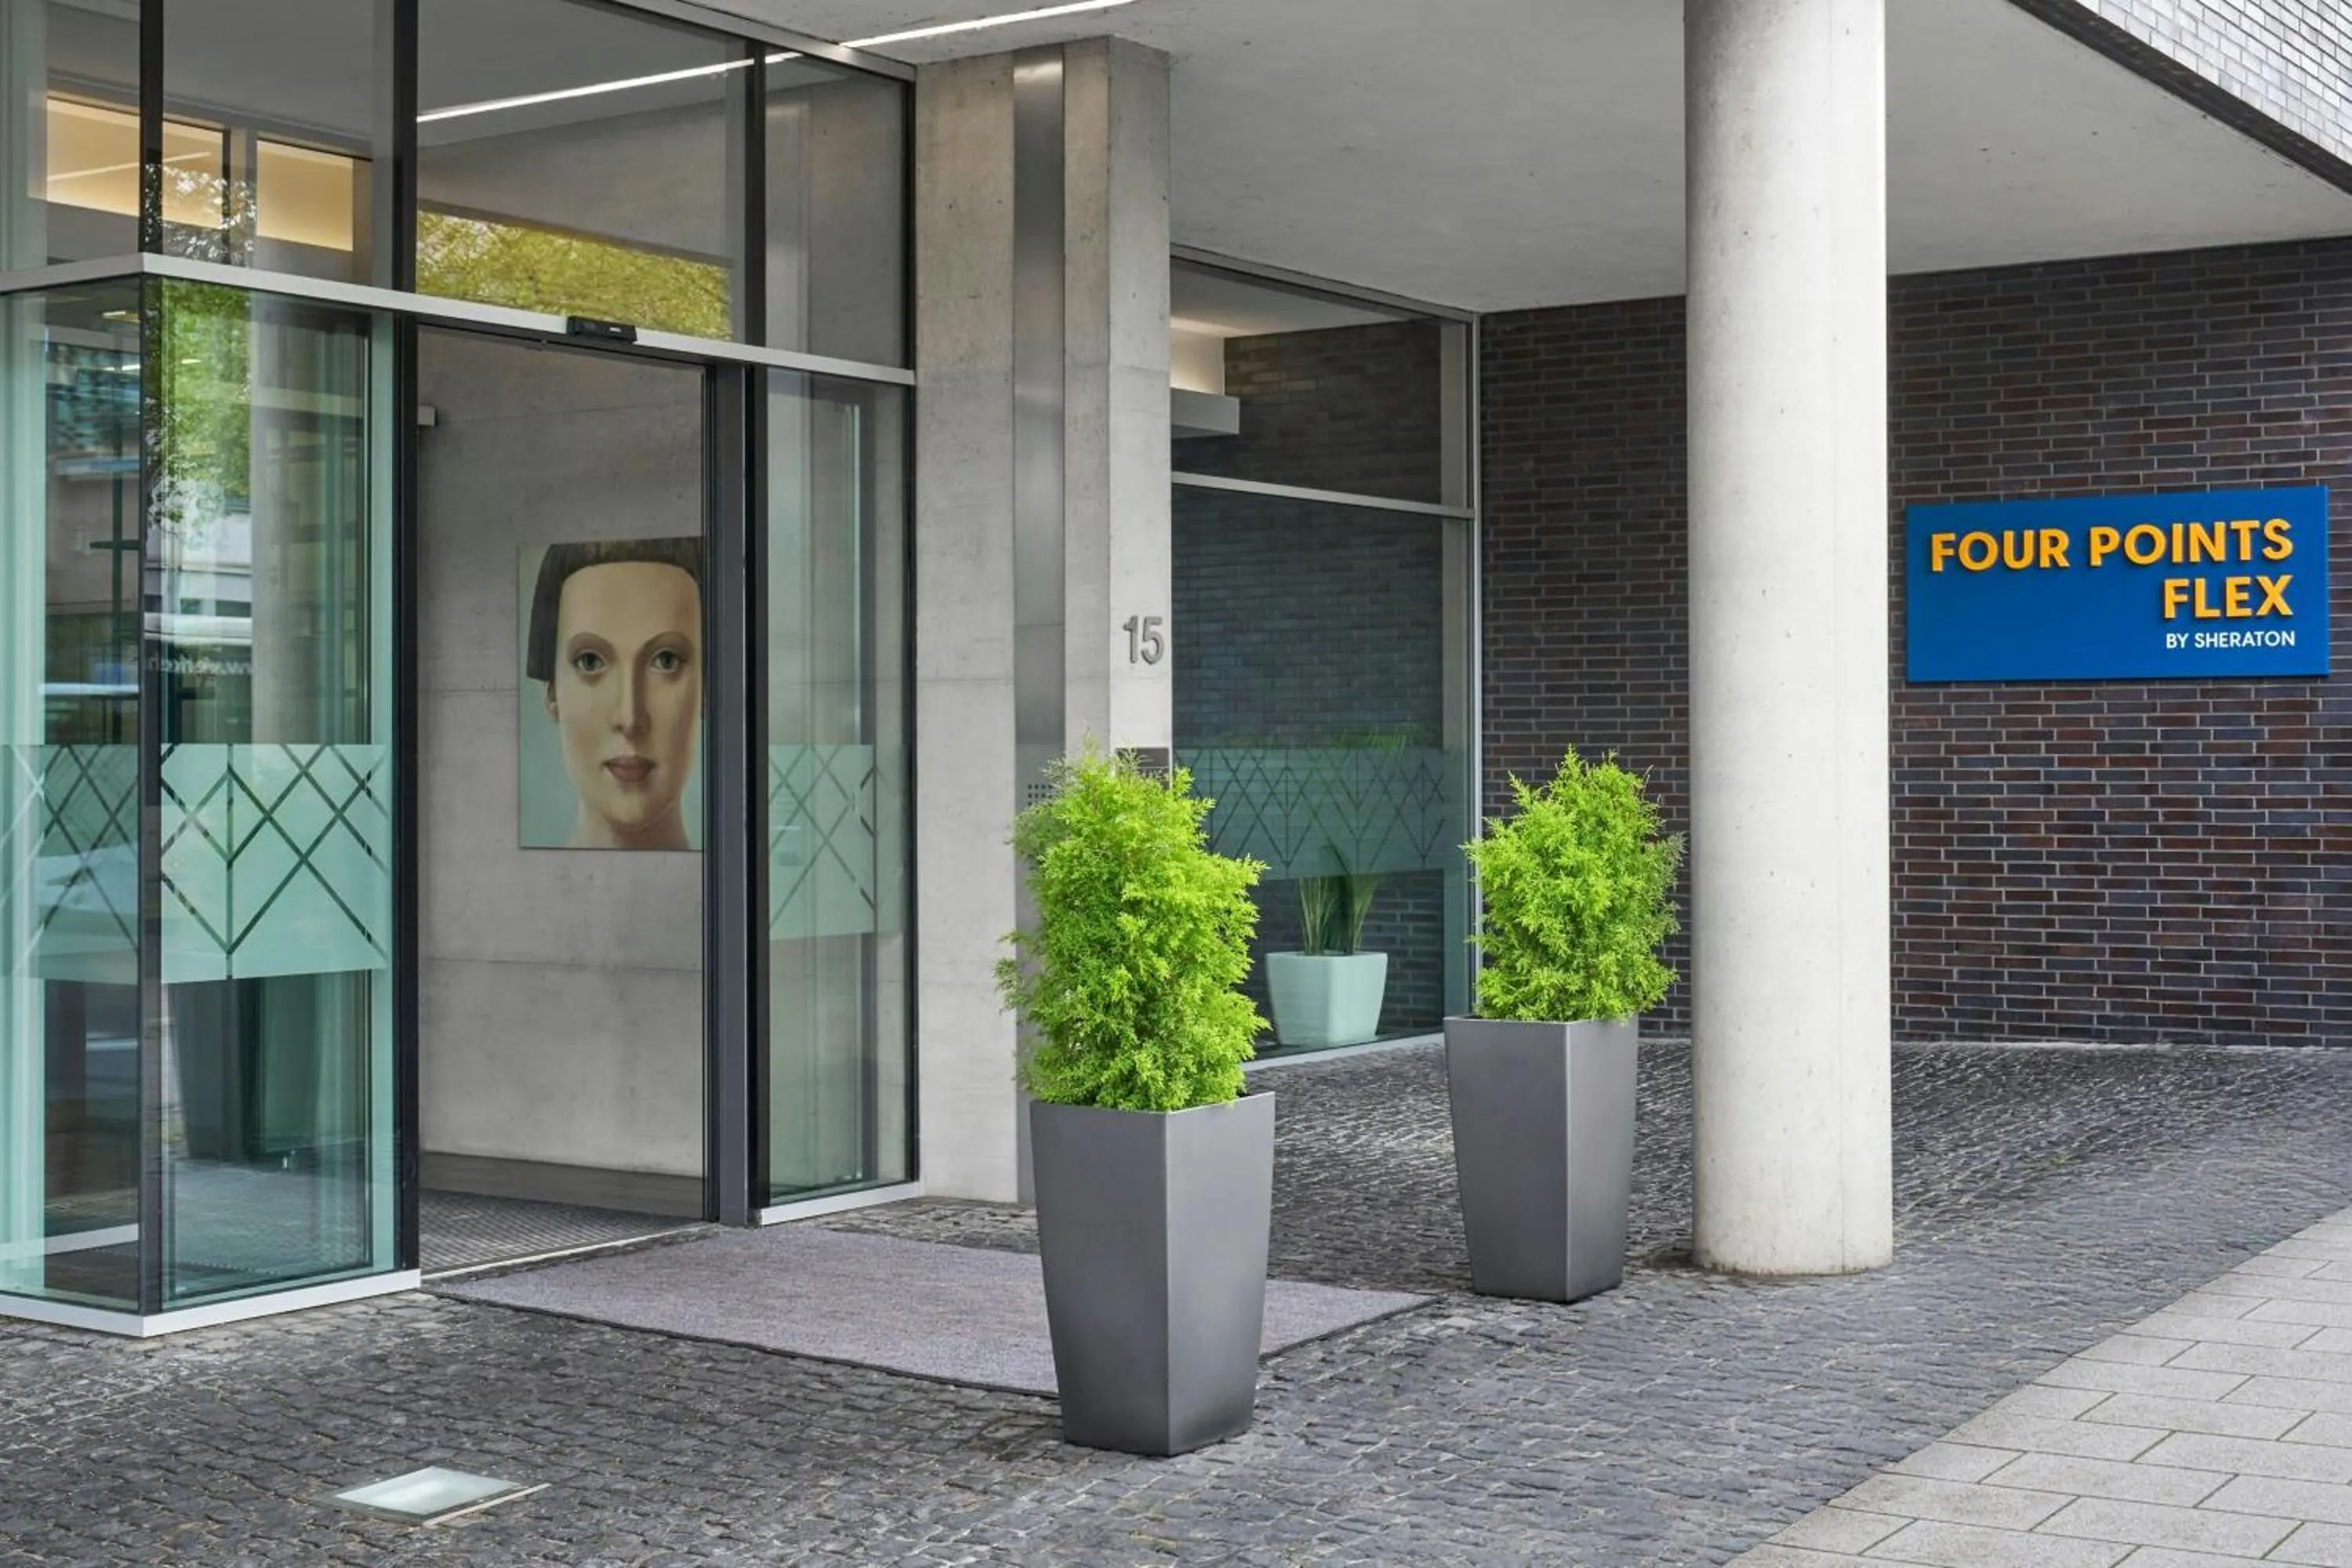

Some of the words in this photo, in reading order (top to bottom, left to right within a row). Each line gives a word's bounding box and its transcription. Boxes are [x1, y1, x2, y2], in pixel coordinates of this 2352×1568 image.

[1931, 528, 2070, 572] FOUR
[2089, 518, 2293, 568] POINTS
[2164, 575, 2293, 619] FLEX
[1123, 615, 1164, 666] 15
[2166, 633, 2189, 649] BY
[2194, 630, 2296, 648] SHERATON
